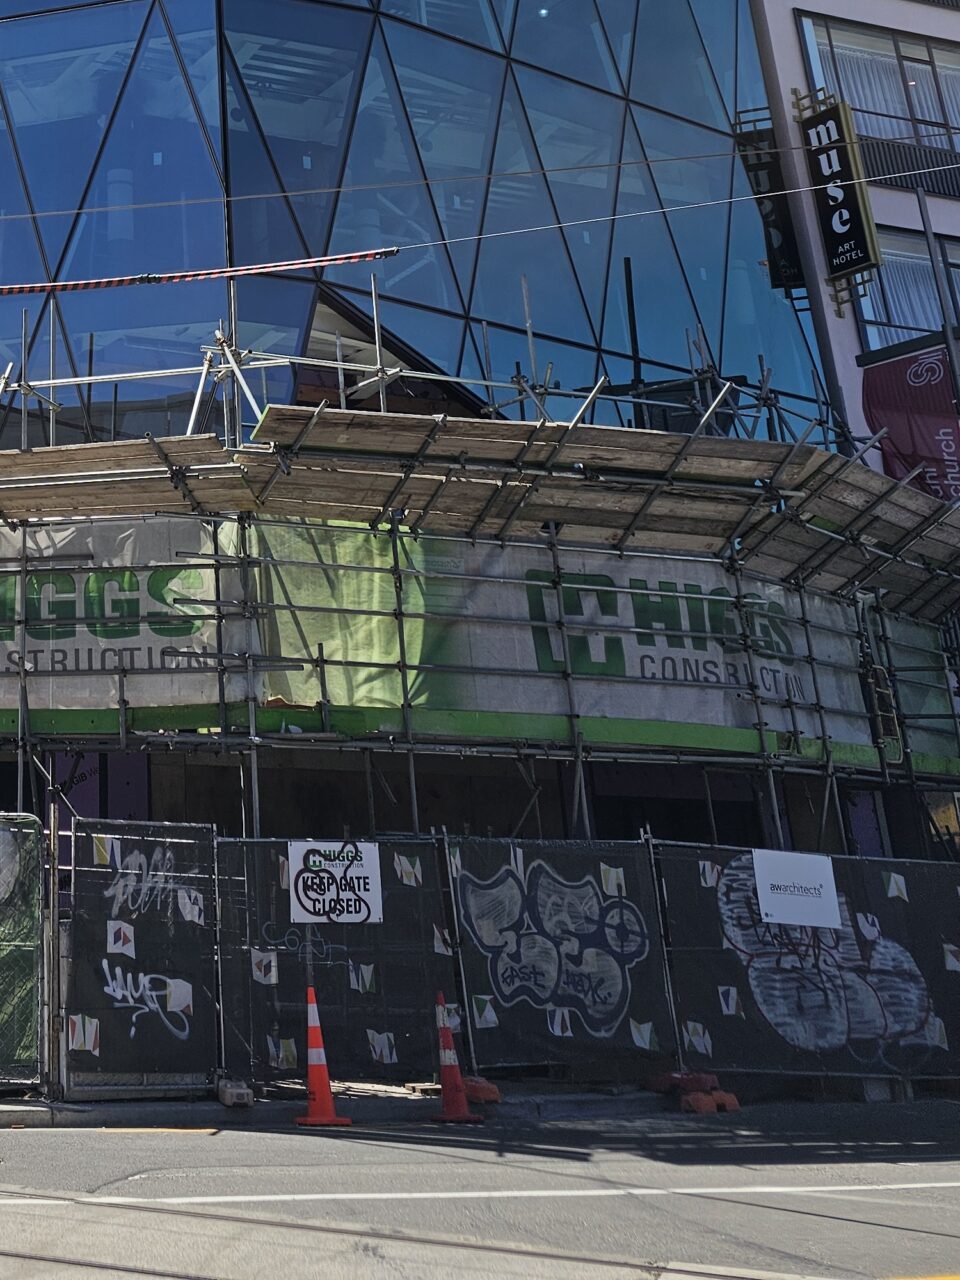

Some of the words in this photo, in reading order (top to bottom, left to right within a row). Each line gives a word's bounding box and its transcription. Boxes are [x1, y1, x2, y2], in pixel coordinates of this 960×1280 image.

[808, 120, 851, 233] muse
[838, 240, 856, 253] ART
[833, 250, 865, 266] HOTEL
[629, 578, 795, 666] HIGGS
[324, 850, 363, 862] HIGGS
[302, 876, 335, 892] KEEP
[340, 876, 370, 892] GATE
[770, 882, 821, 896] awarchitects
[313, 898, 362, 915] CLOSED
